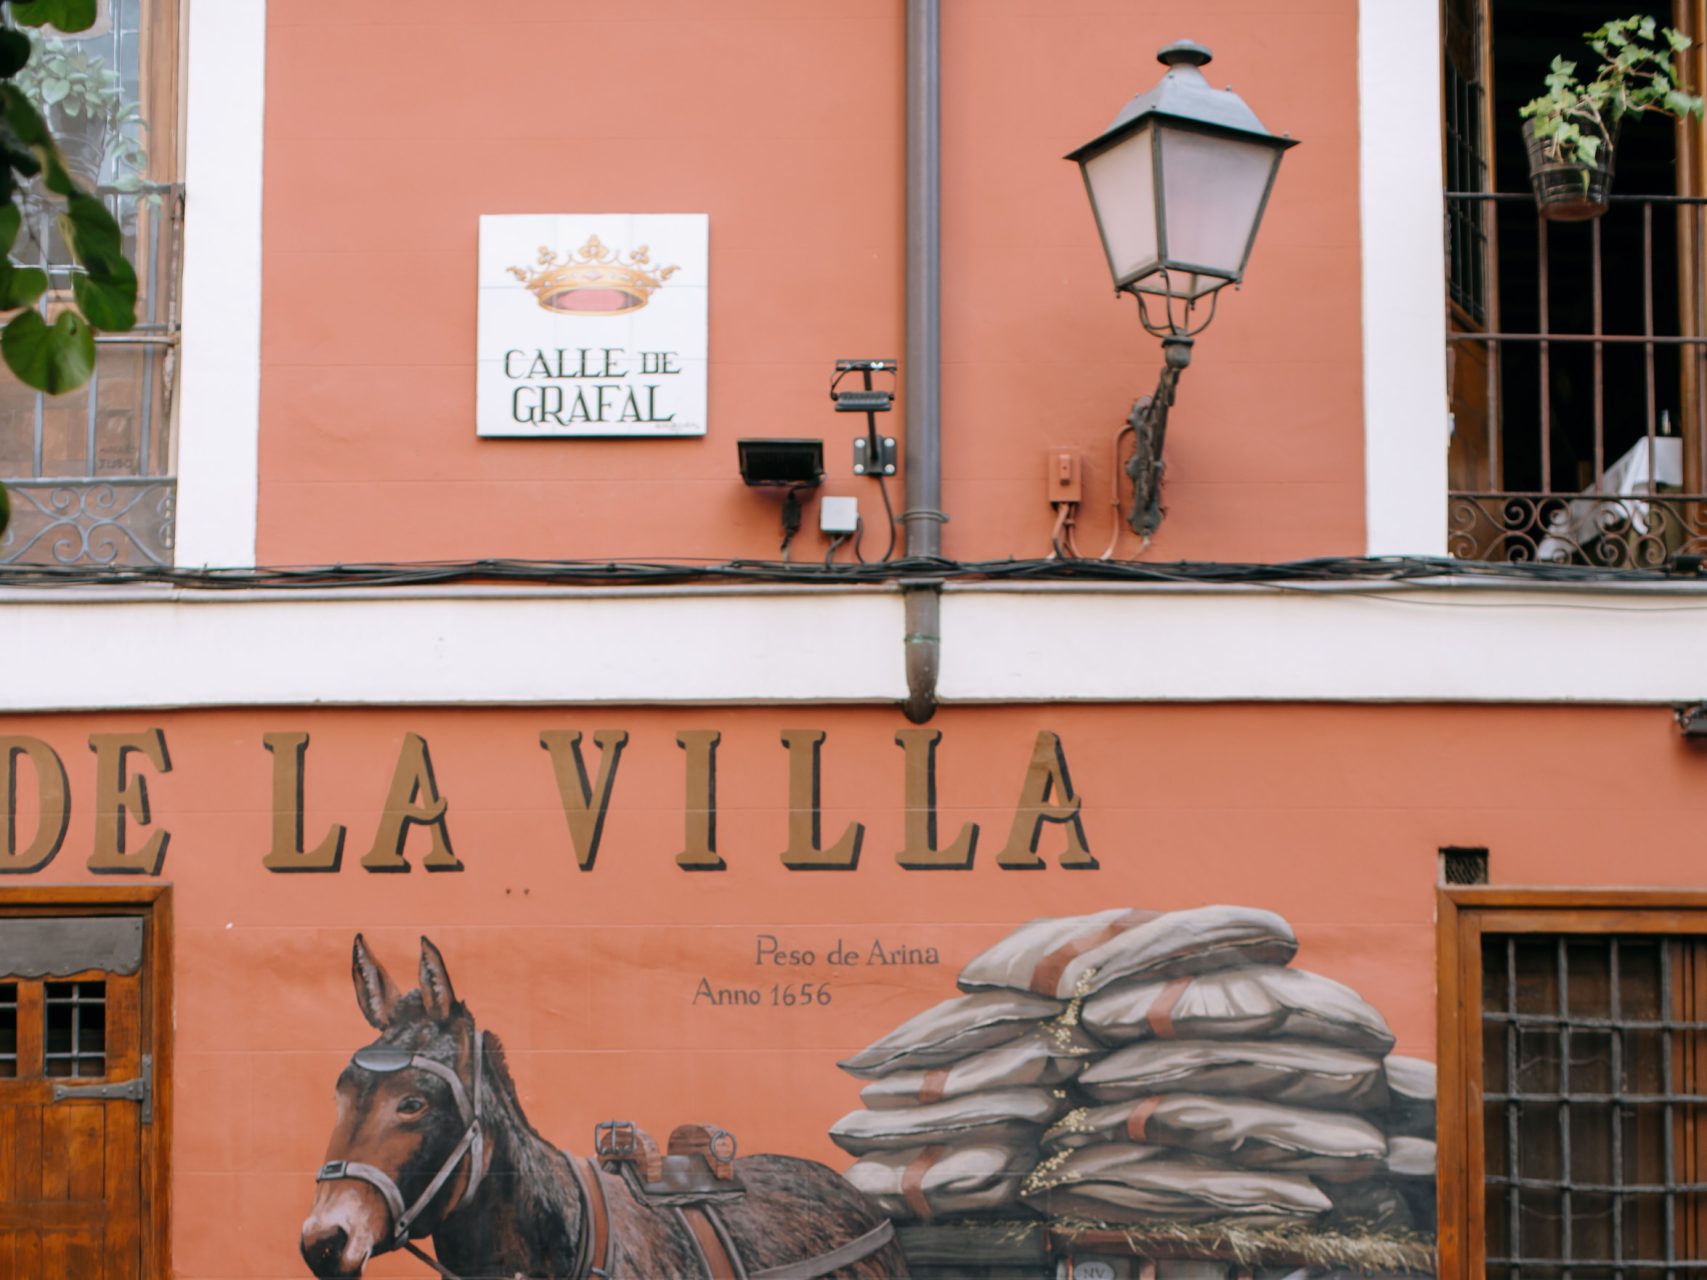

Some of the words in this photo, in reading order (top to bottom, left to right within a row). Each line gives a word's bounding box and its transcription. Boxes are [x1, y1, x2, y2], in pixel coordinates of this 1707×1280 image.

[504, 347, 629, 379] CALLE
[637, 351, 682, 375] DE
[512, 384, 676, 427] GRAFAL
[0, 728, 173, 876] DE
[262, 730, 465, 873] LA
[539, 729, 1100, 872] VILLA
[755, 934, 816, 966] Peso
[827, 938, 860, 966] de
[866, 938, 940, 966] Arina
[692, 976, 761, 1006] Anno
[771, 982, 832, 1007] 1656
